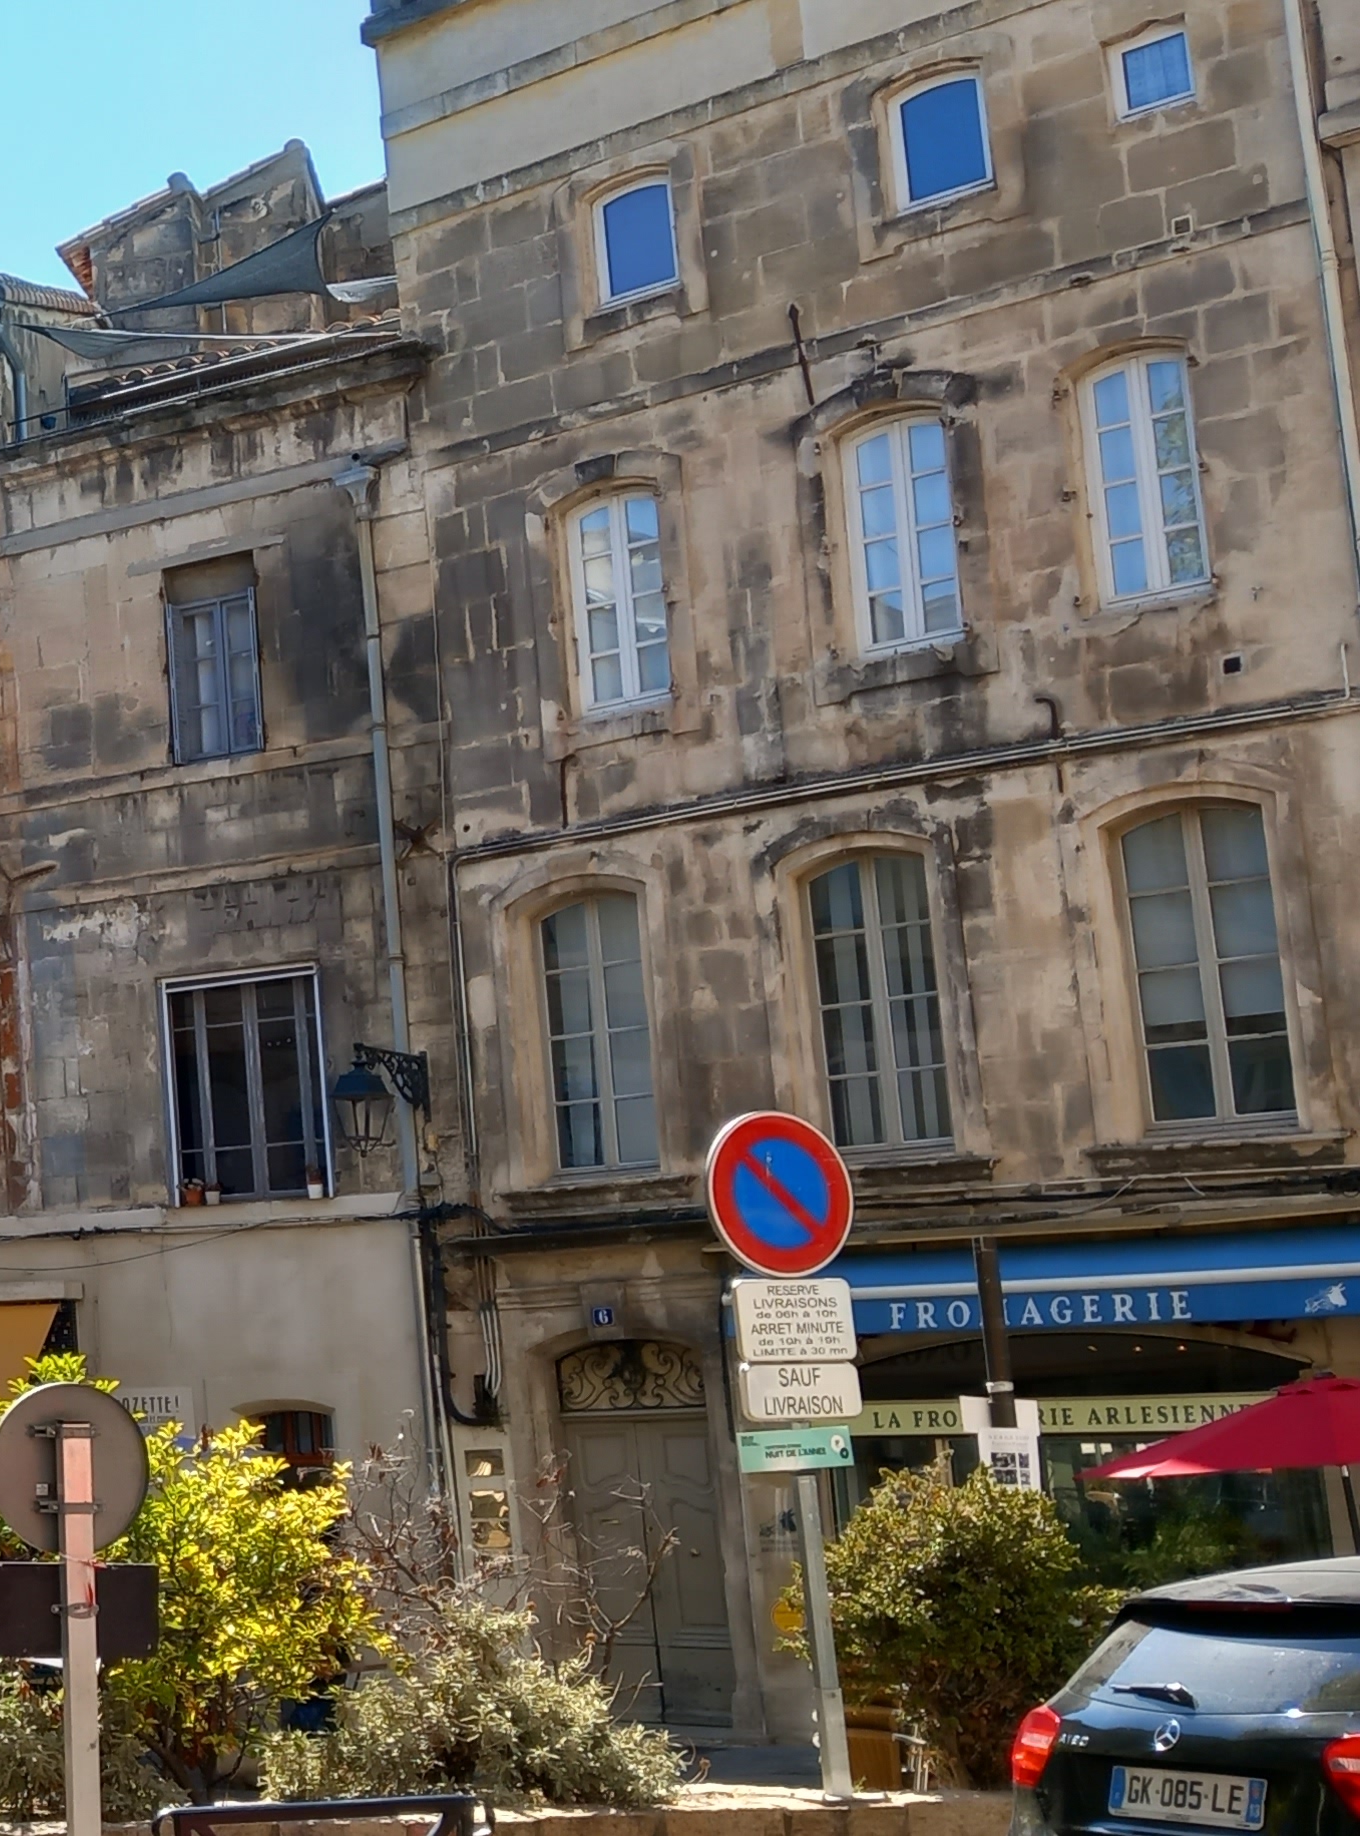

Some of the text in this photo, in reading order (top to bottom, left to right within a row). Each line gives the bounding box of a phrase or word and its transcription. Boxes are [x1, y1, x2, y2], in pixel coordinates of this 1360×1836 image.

[766, 1285, 820, 1296] RESERVE
[752, 1297, 838, 1310] LIVRAISONS
[889, 1290, 1193, 1331] FROAGERIE
[598, 1309, 609, 1324] 6
[755, 1310, 771, 1319] de
[803, 1309, 811, 1318] à
[815, 1309, 838, 1318] 10h
[751, 1321, 845, 1335] ARRET MINUTE
[758, 1338, 774, 1346] de
[753, 1347, 797, 1357] LIMITE
[810, 1347, 826, 1356] 30
[829, 1347, 848, 1355] mn
[778, 1367, 821, 1388] SAUF
[764, 1395, 844, 1416] LIVRAISON
[873, 1402, 1253, 1430] LA FRORIE ARLESIENN
[1127, 1775, 1245, 1815] GK-085-LE
